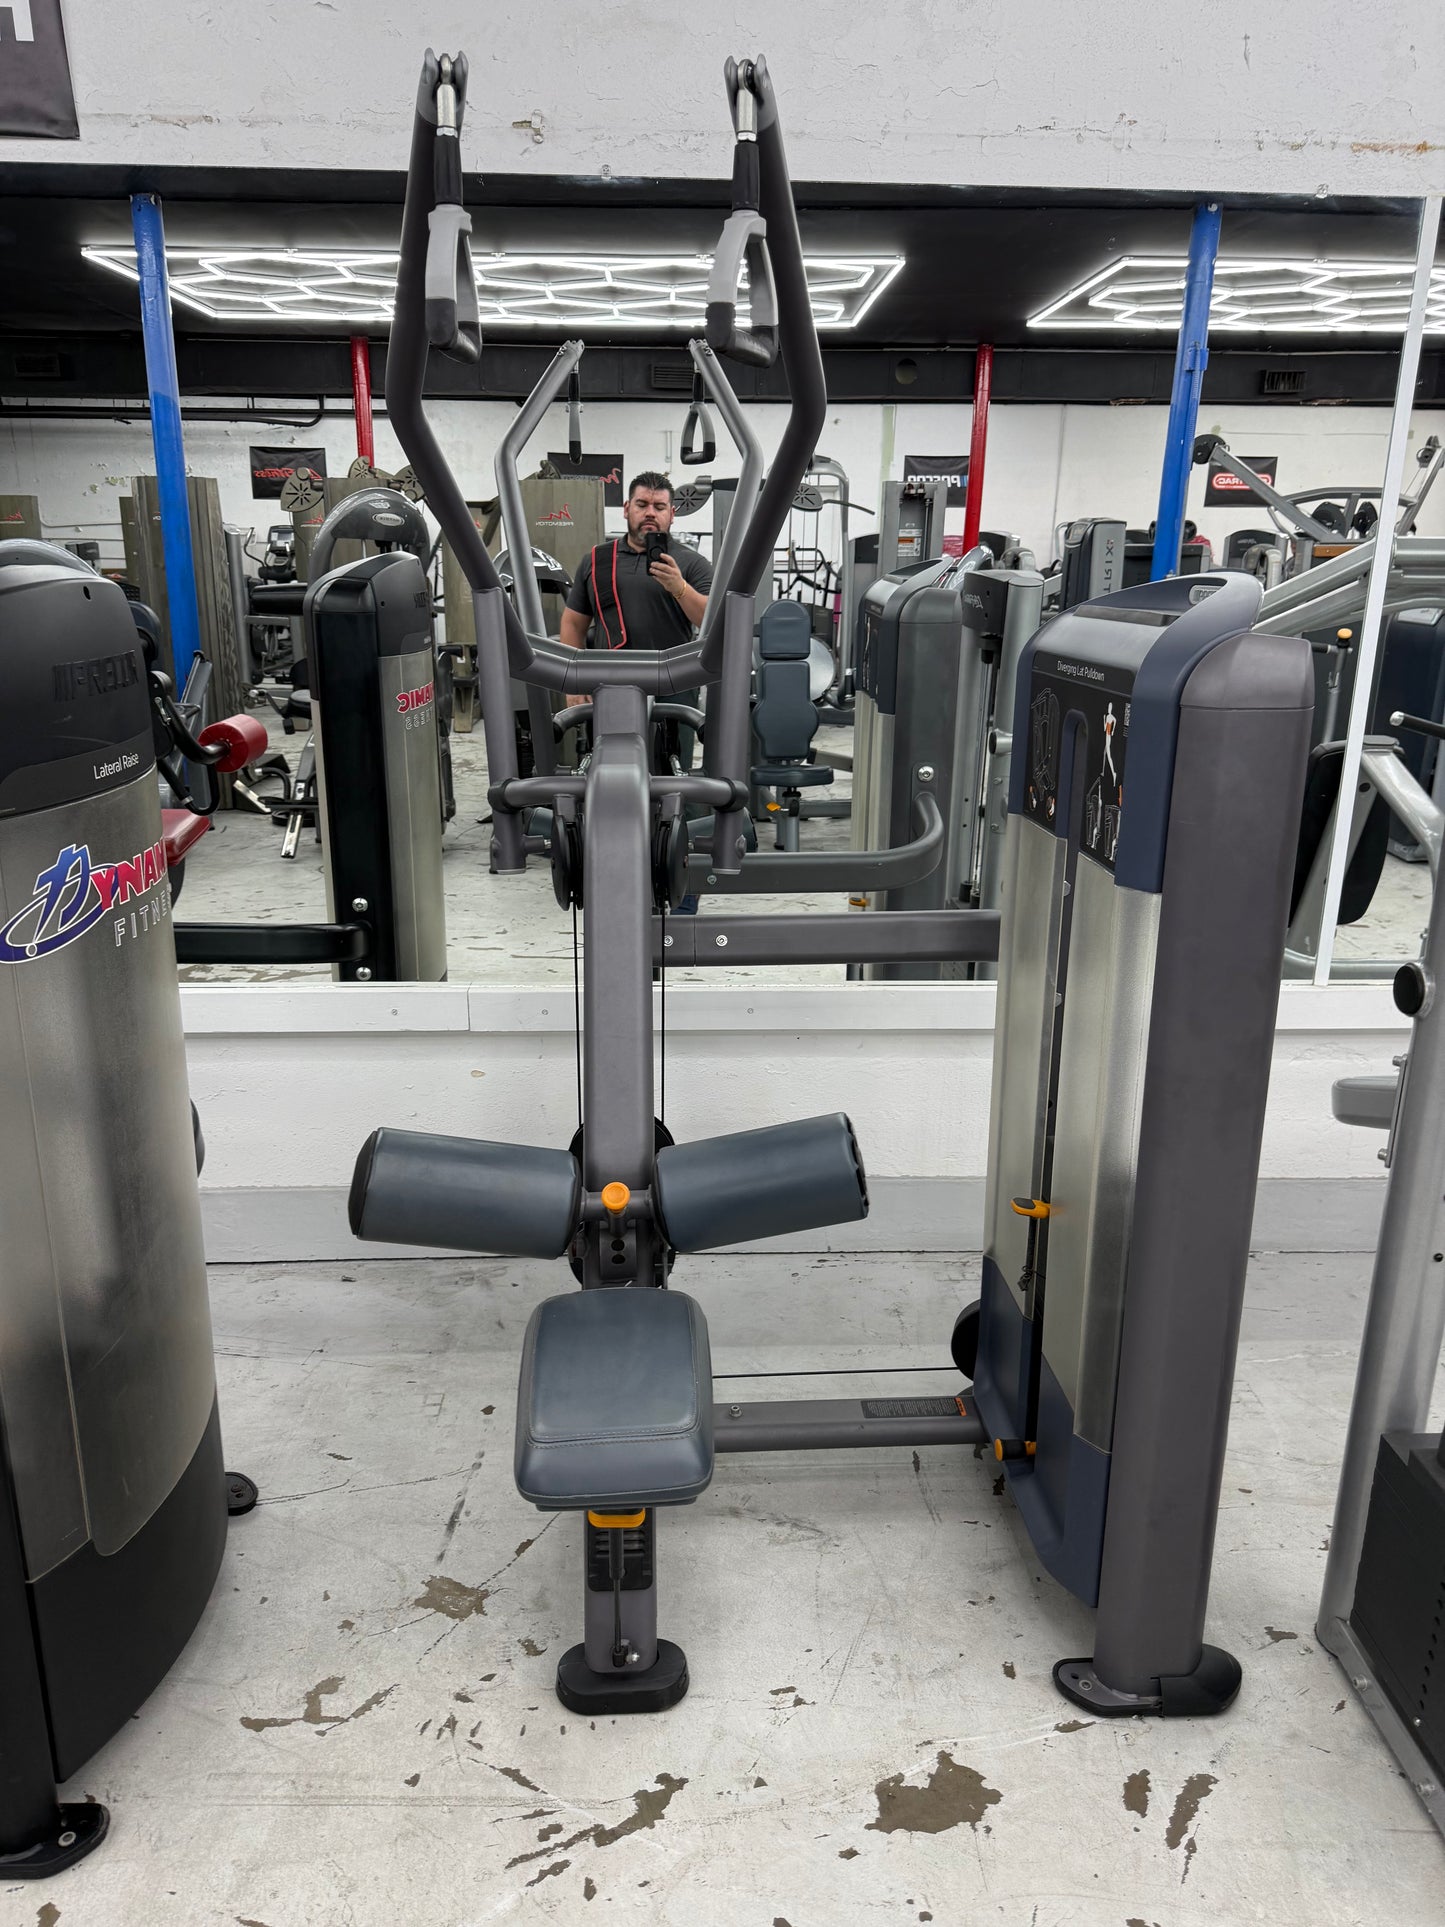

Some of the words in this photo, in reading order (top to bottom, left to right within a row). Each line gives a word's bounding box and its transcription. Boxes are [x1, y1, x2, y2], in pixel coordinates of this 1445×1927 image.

[1057, 660, 1077, 677] Diverging
[1077, 665, 1085, 677] Lat
[1085, 666, 1105, 681] Pulldown
[93, 756, 122, 780] Lateral
[123, 752, 139, 769] Raise
